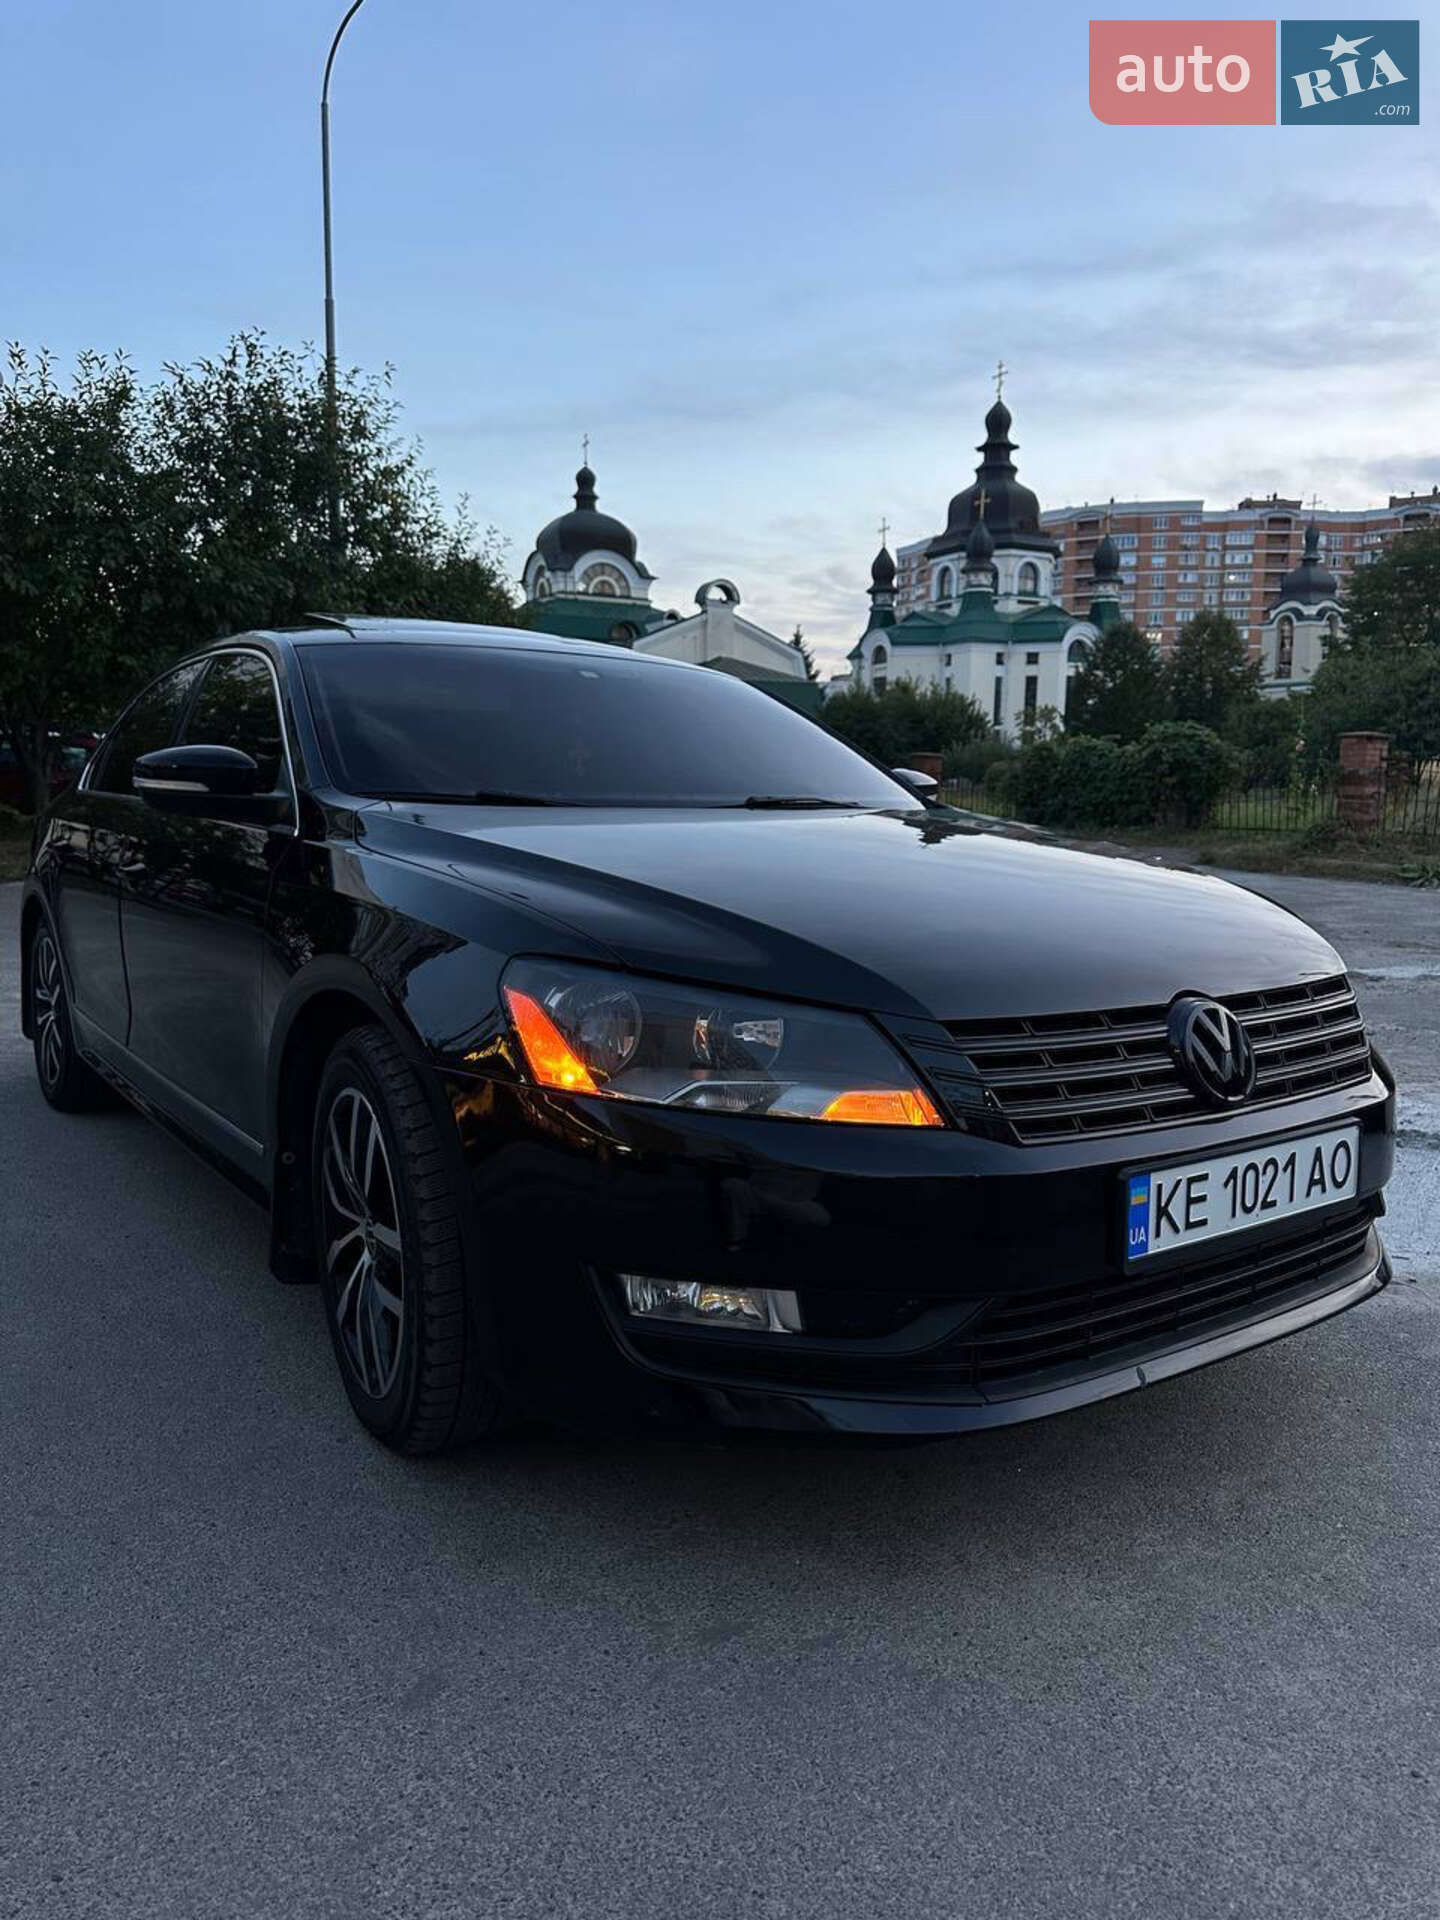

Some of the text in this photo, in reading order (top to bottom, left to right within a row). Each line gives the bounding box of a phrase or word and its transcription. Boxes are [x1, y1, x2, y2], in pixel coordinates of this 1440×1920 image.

[1154, 1139, 1352, 1239] KE 1021 AO
[1129, 1226, 1147, 1245] UA
